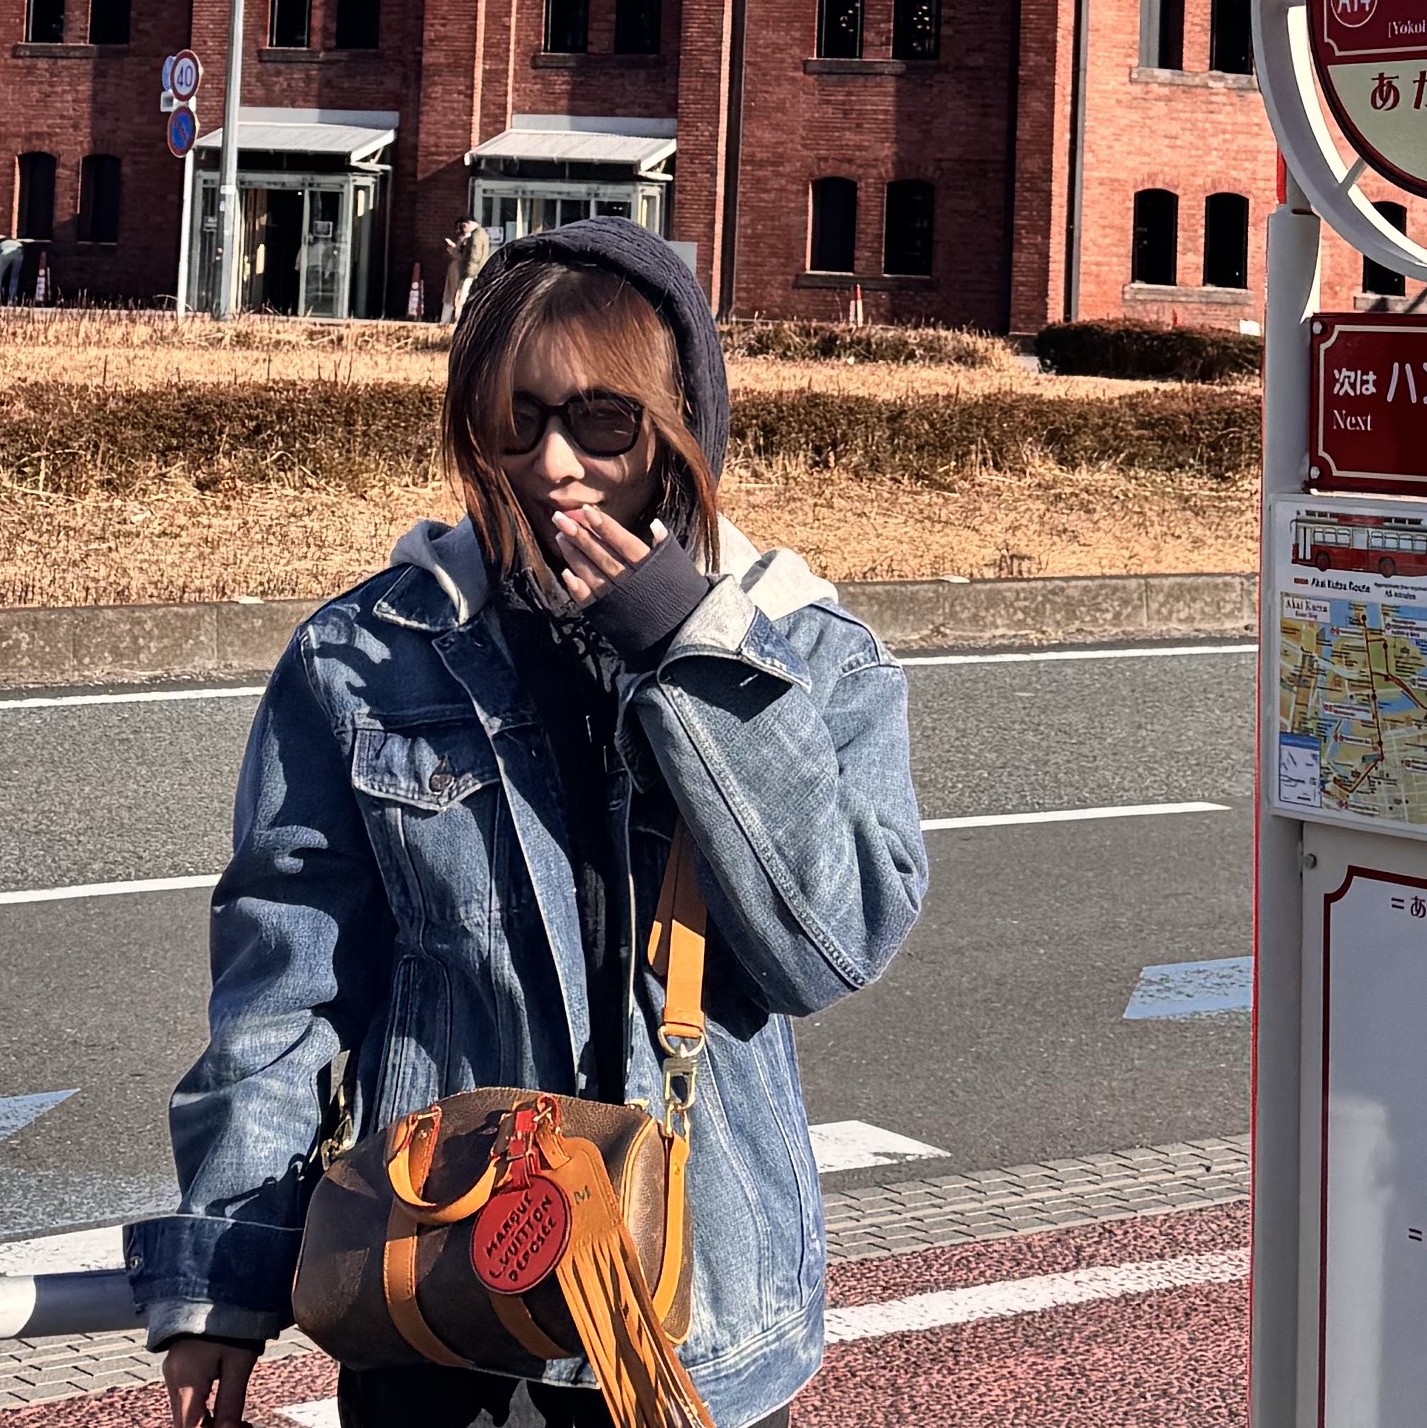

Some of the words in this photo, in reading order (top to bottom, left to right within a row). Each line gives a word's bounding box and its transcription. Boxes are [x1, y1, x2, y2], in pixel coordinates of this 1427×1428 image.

[177, 65, 193, 87] 40
[1332, 368, 1377, 396] 次は
[1332, 409, 1372, 432] Next
